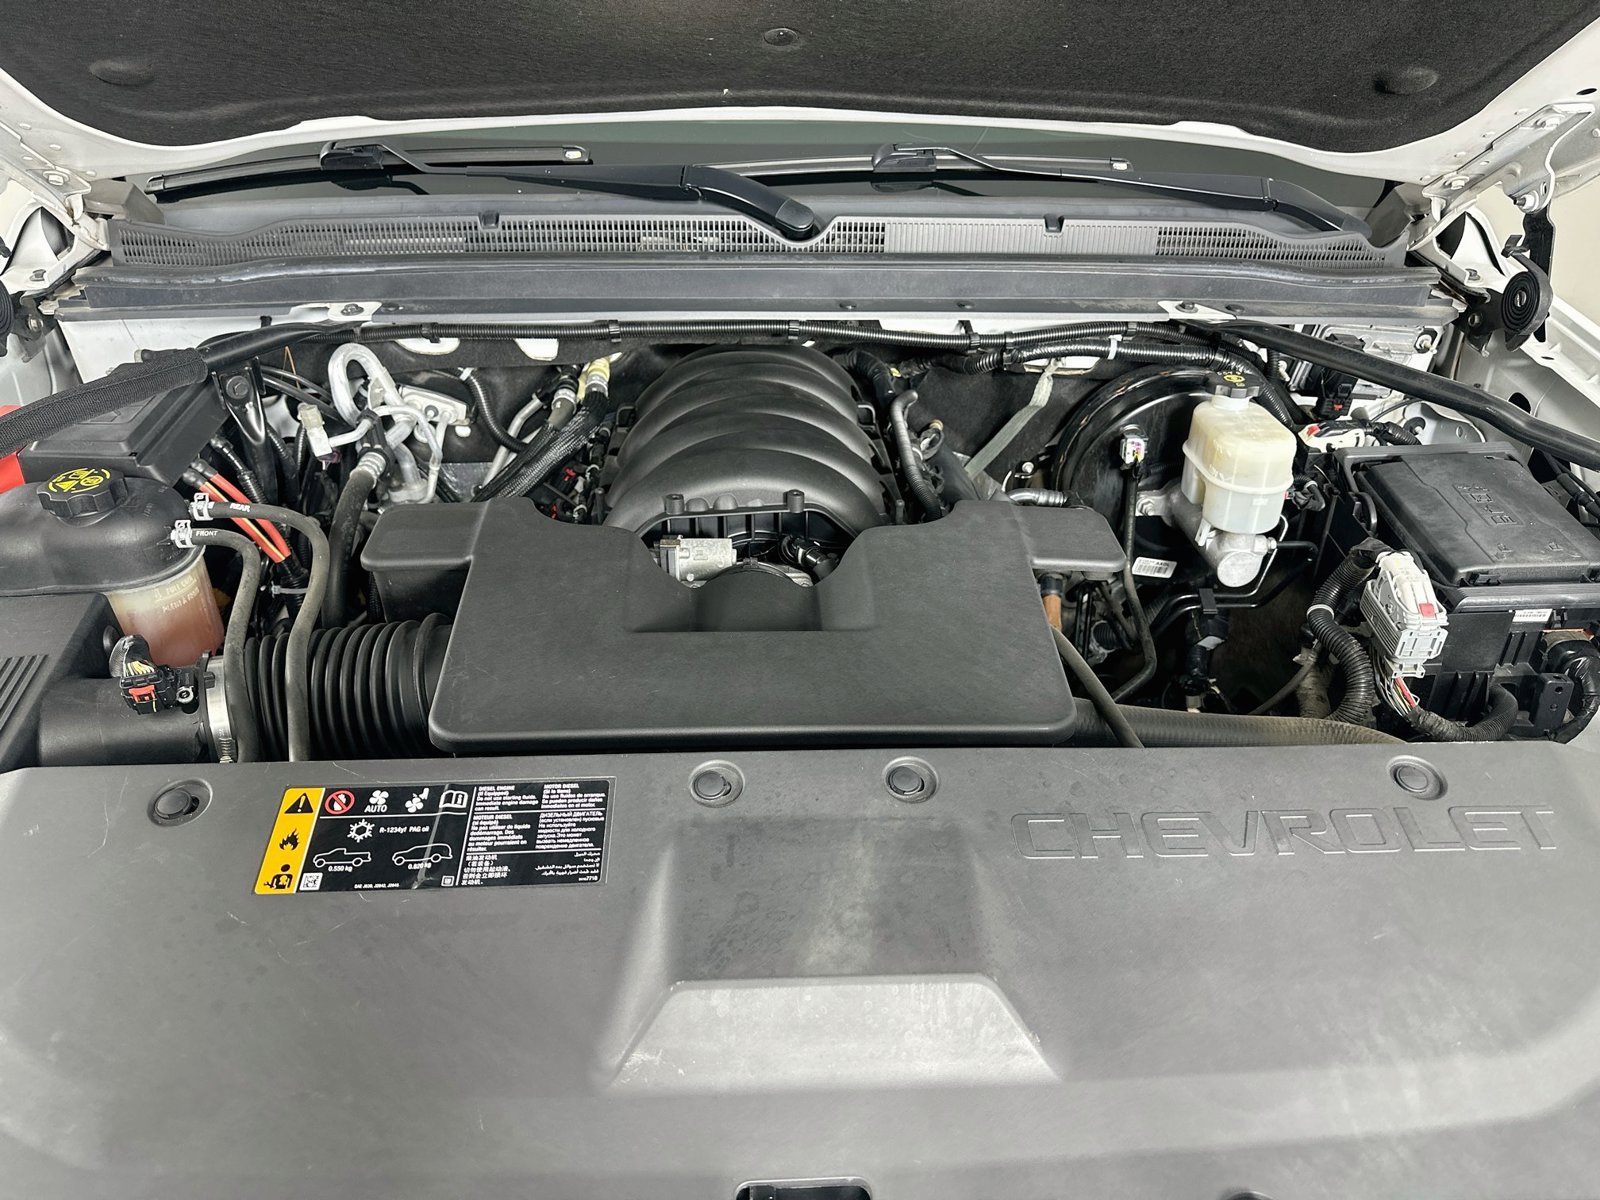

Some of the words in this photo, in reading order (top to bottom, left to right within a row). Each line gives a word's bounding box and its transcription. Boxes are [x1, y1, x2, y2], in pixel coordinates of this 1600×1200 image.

[229, 502, 251, 513] REAR
[195, 530, 219, 538] FRONT
[363, 804, 388, 814] AUTO
[408, 825, 421, 833] PAG
[421, 825, 430, 833] oil
[1010, 804, 1558, 860] CHEVROLET
[344, 864, 353, 873] kg
